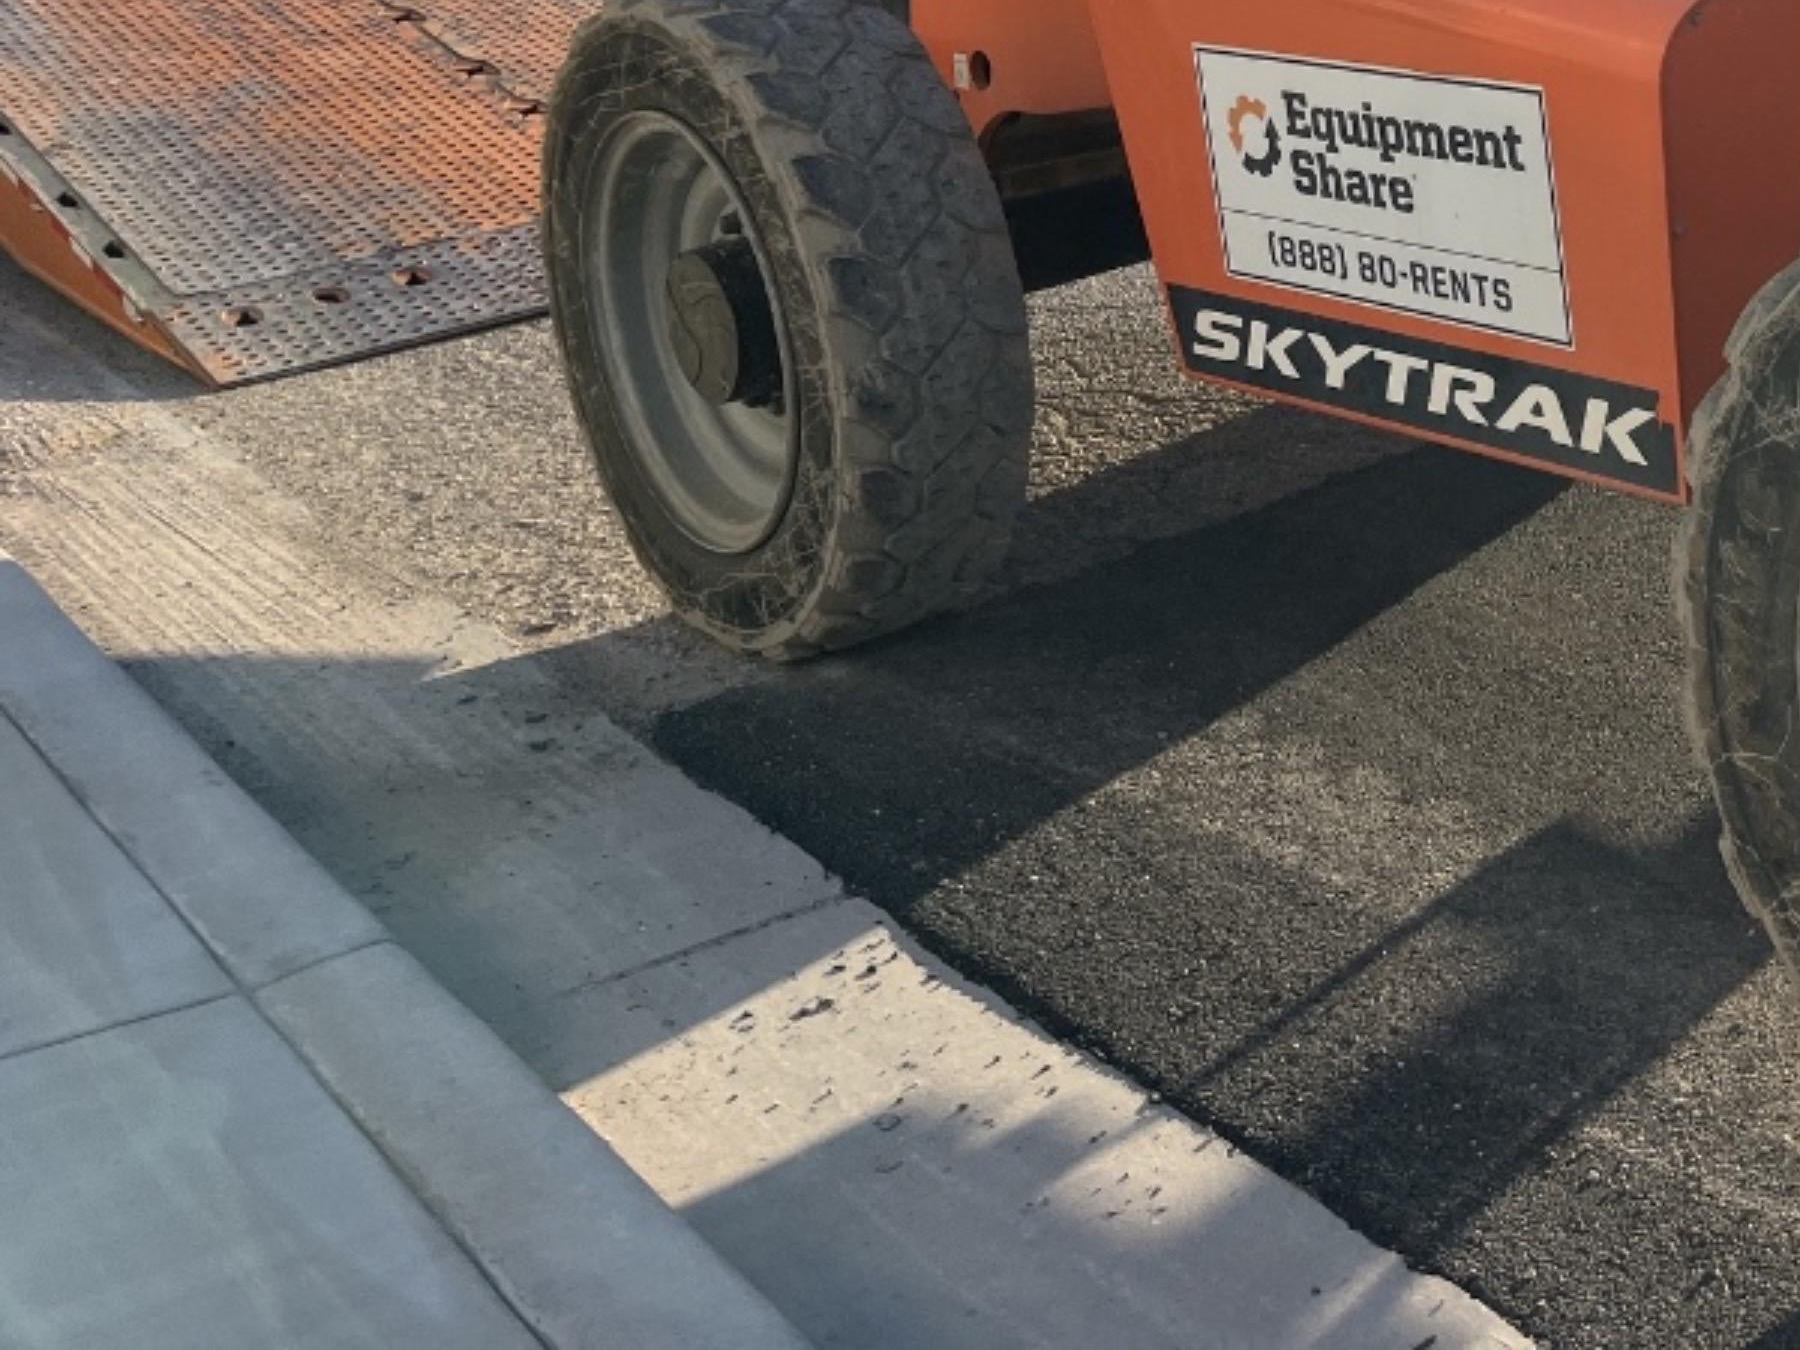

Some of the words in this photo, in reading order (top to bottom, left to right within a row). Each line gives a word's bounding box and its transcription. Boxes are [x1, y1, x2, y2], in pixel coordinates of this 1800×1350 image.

[1281, 91, 1525, 172] Equipment
[1290, 150, 1415, 213] Share
[1267, 230, 1346, 280] (888)
[1358, 252, 1513, 312] 80-RENTS
[1192, 308, 1658, 467] SKYTRAK
